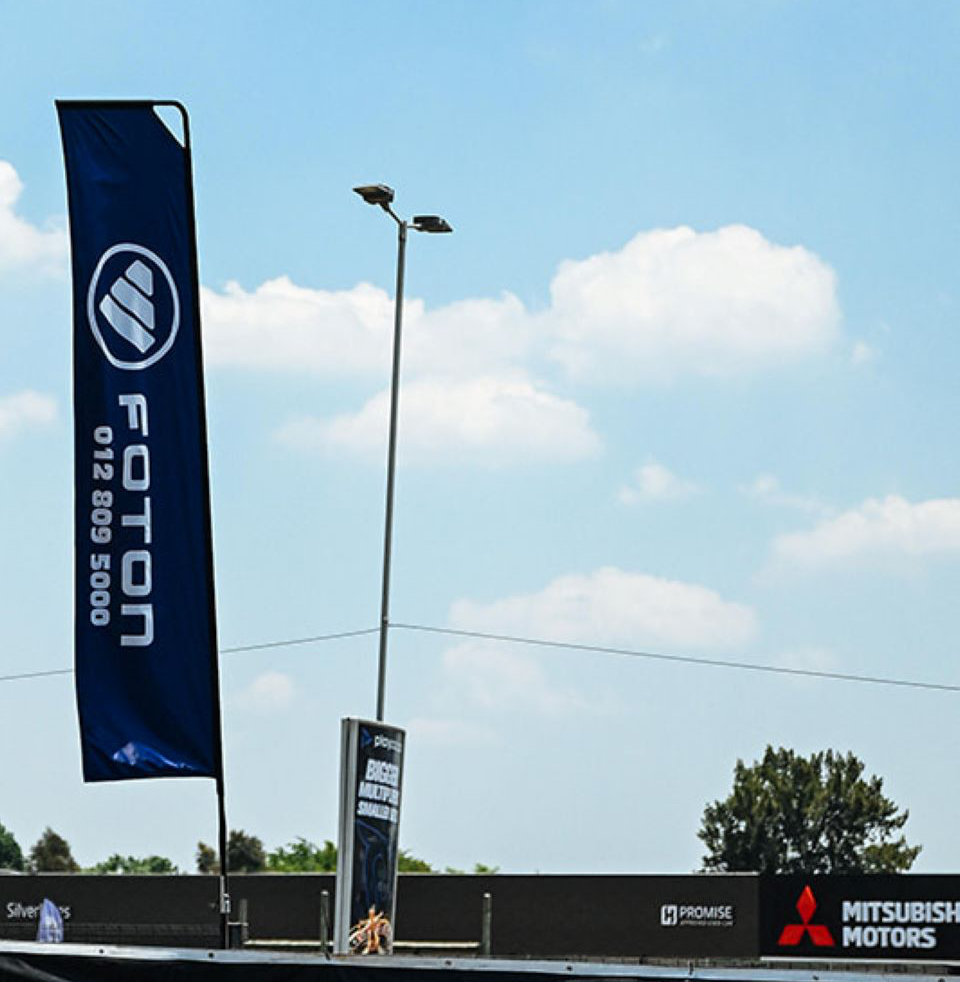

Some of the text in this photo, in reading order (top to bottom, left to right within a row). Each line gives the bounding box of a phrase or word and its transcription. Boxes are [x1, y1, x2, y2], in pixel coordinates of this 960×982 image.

[89, 425, 114, 627] 012 809 5000
[680, 905, 733, 920] PROMISE
[842, 900, 960, 923] MITSUBISH
[842, 926, 937, 949] MOTORS
